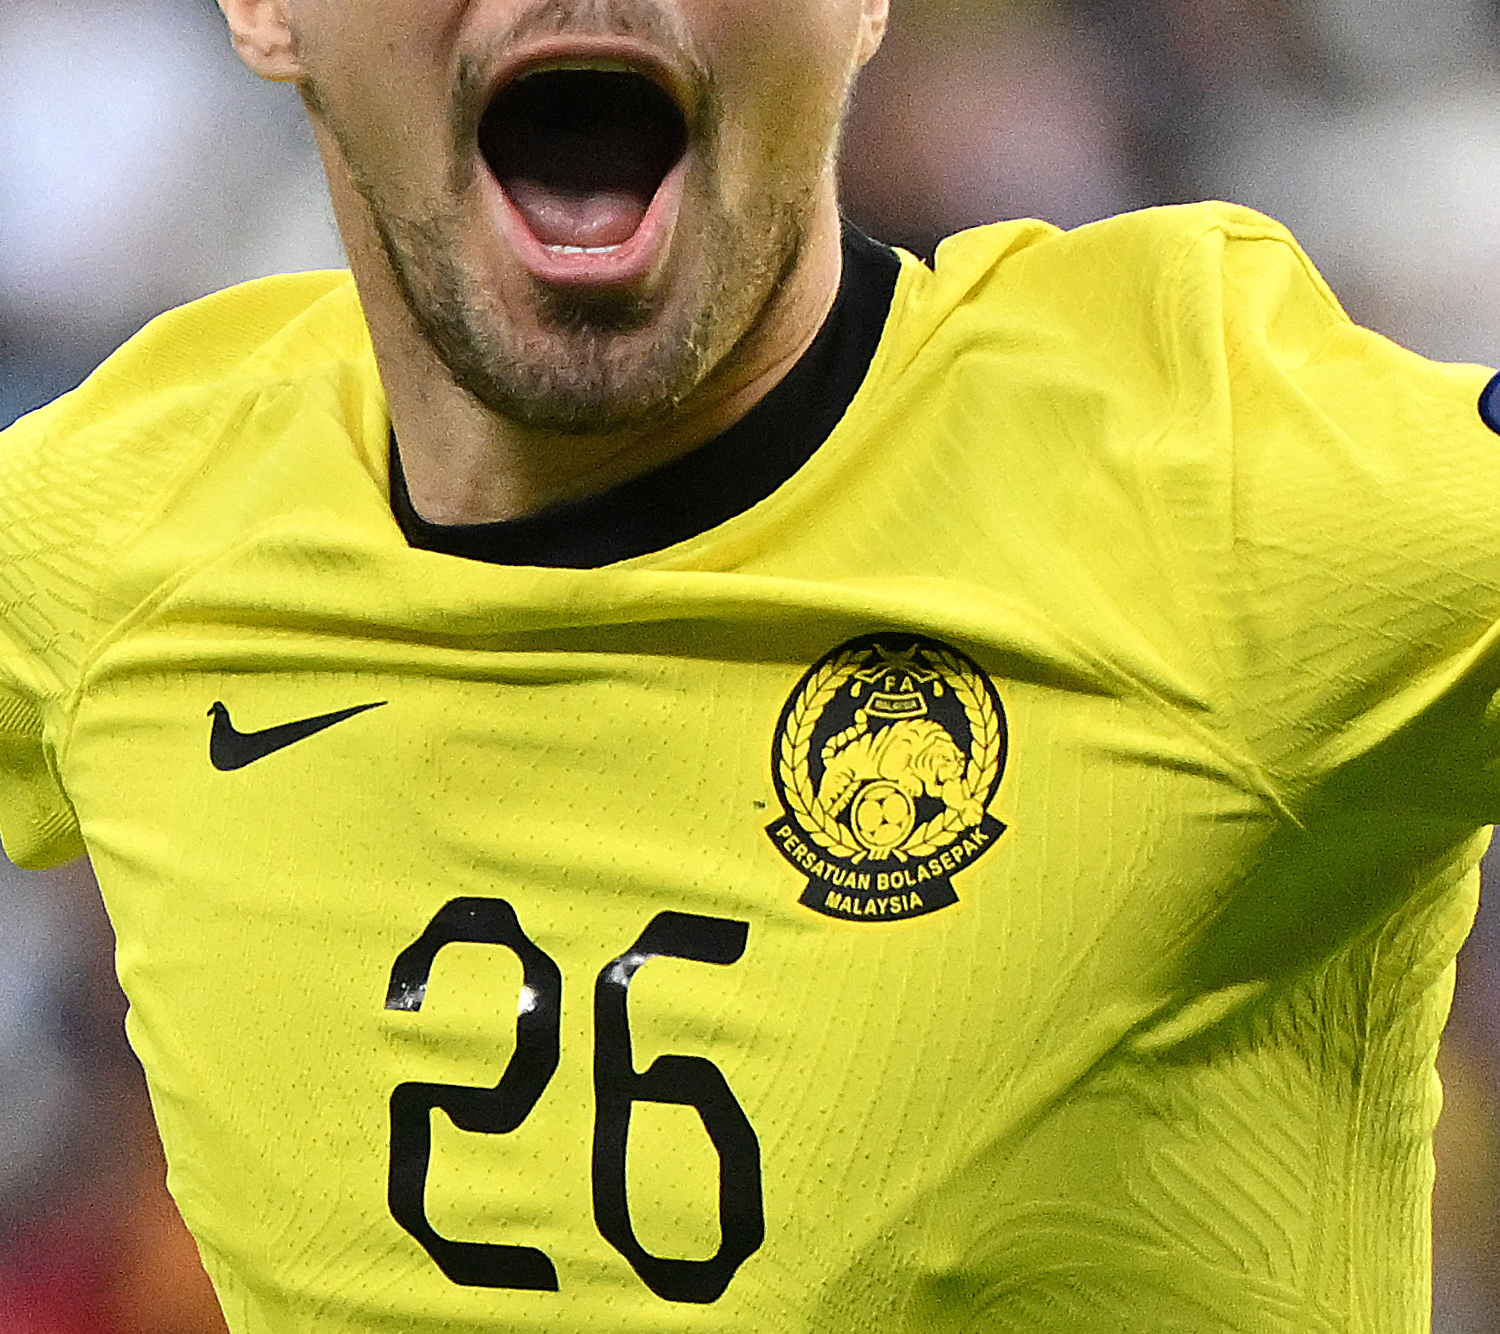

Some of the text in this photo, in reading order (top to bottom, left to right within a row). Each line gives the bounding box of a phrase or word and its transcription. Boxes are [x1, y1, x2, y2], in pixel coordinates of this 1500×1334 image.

[776, 824, 990, 891] PERSATUAN BOLASEPAK
[824, 890, 924, 916] MALAYSIA
[385, 896, 765, 1305] 26
